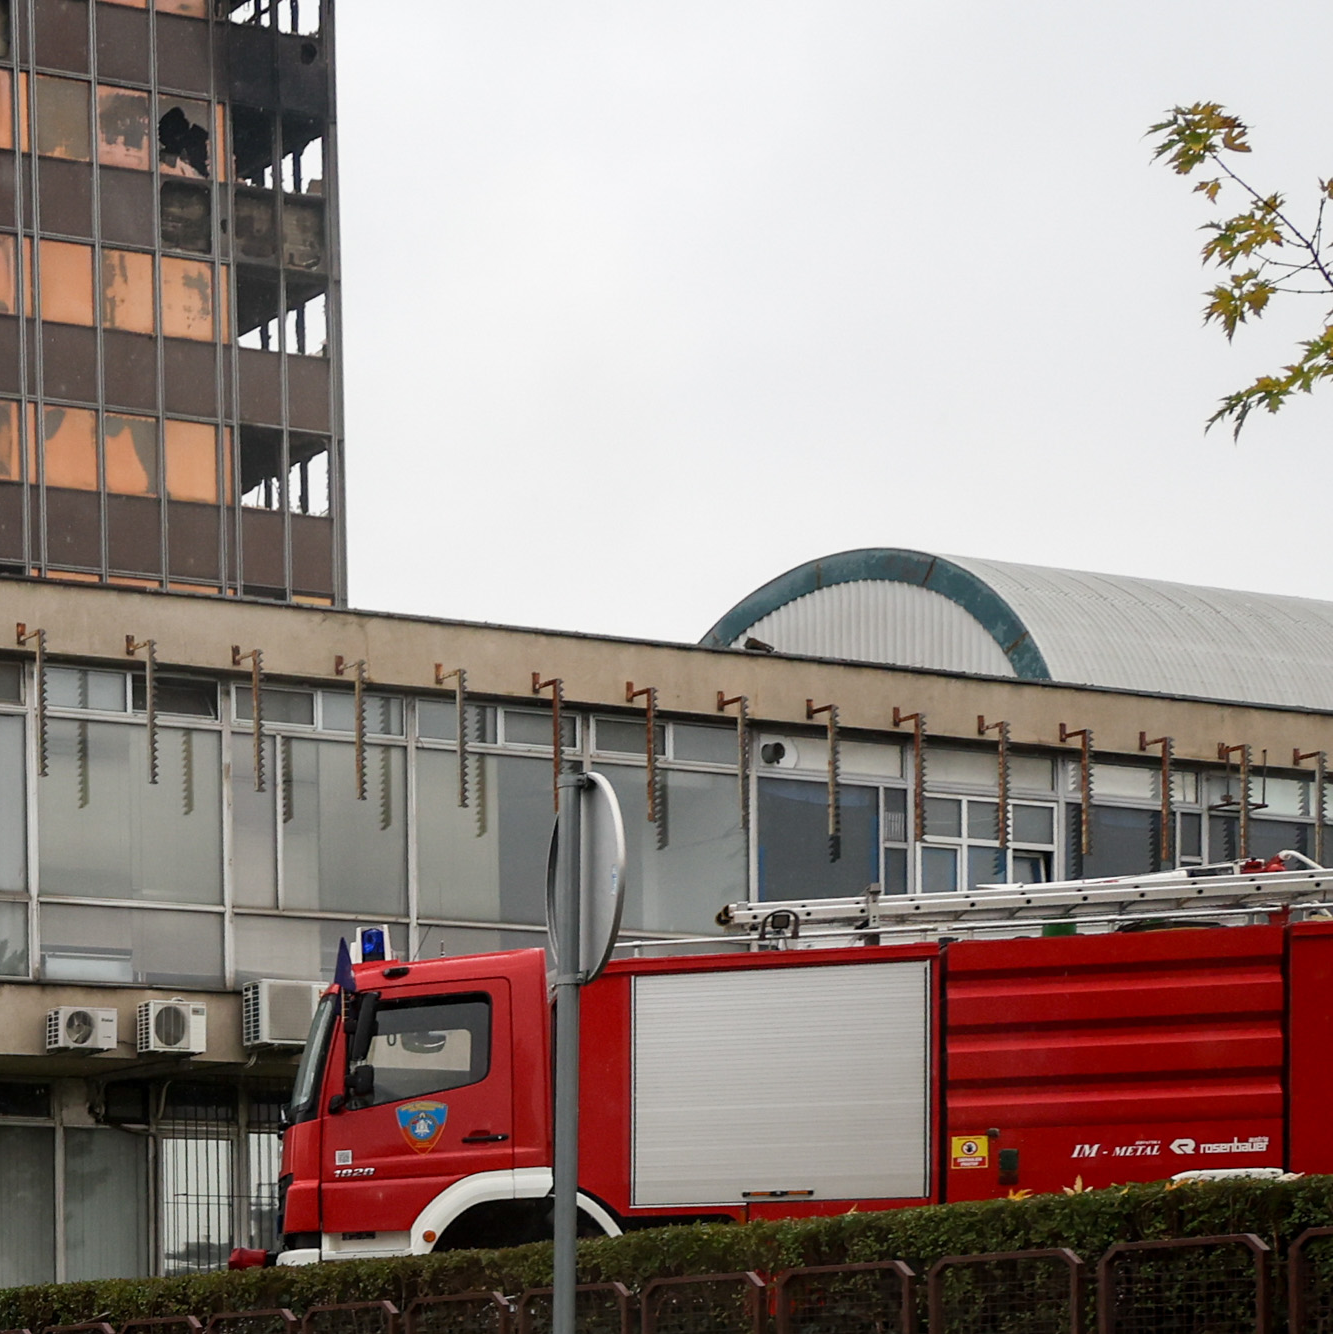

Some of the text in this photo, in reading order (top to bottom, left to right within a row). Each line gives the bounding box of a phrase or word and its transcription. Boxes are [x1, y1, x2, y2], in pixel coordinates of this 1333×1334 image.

[1071, 1144, 1100, 1158] IM
[1112, 1145, 1161, 1157] METAL
[1200, 1137, 1269, 1154] rosenbauer
